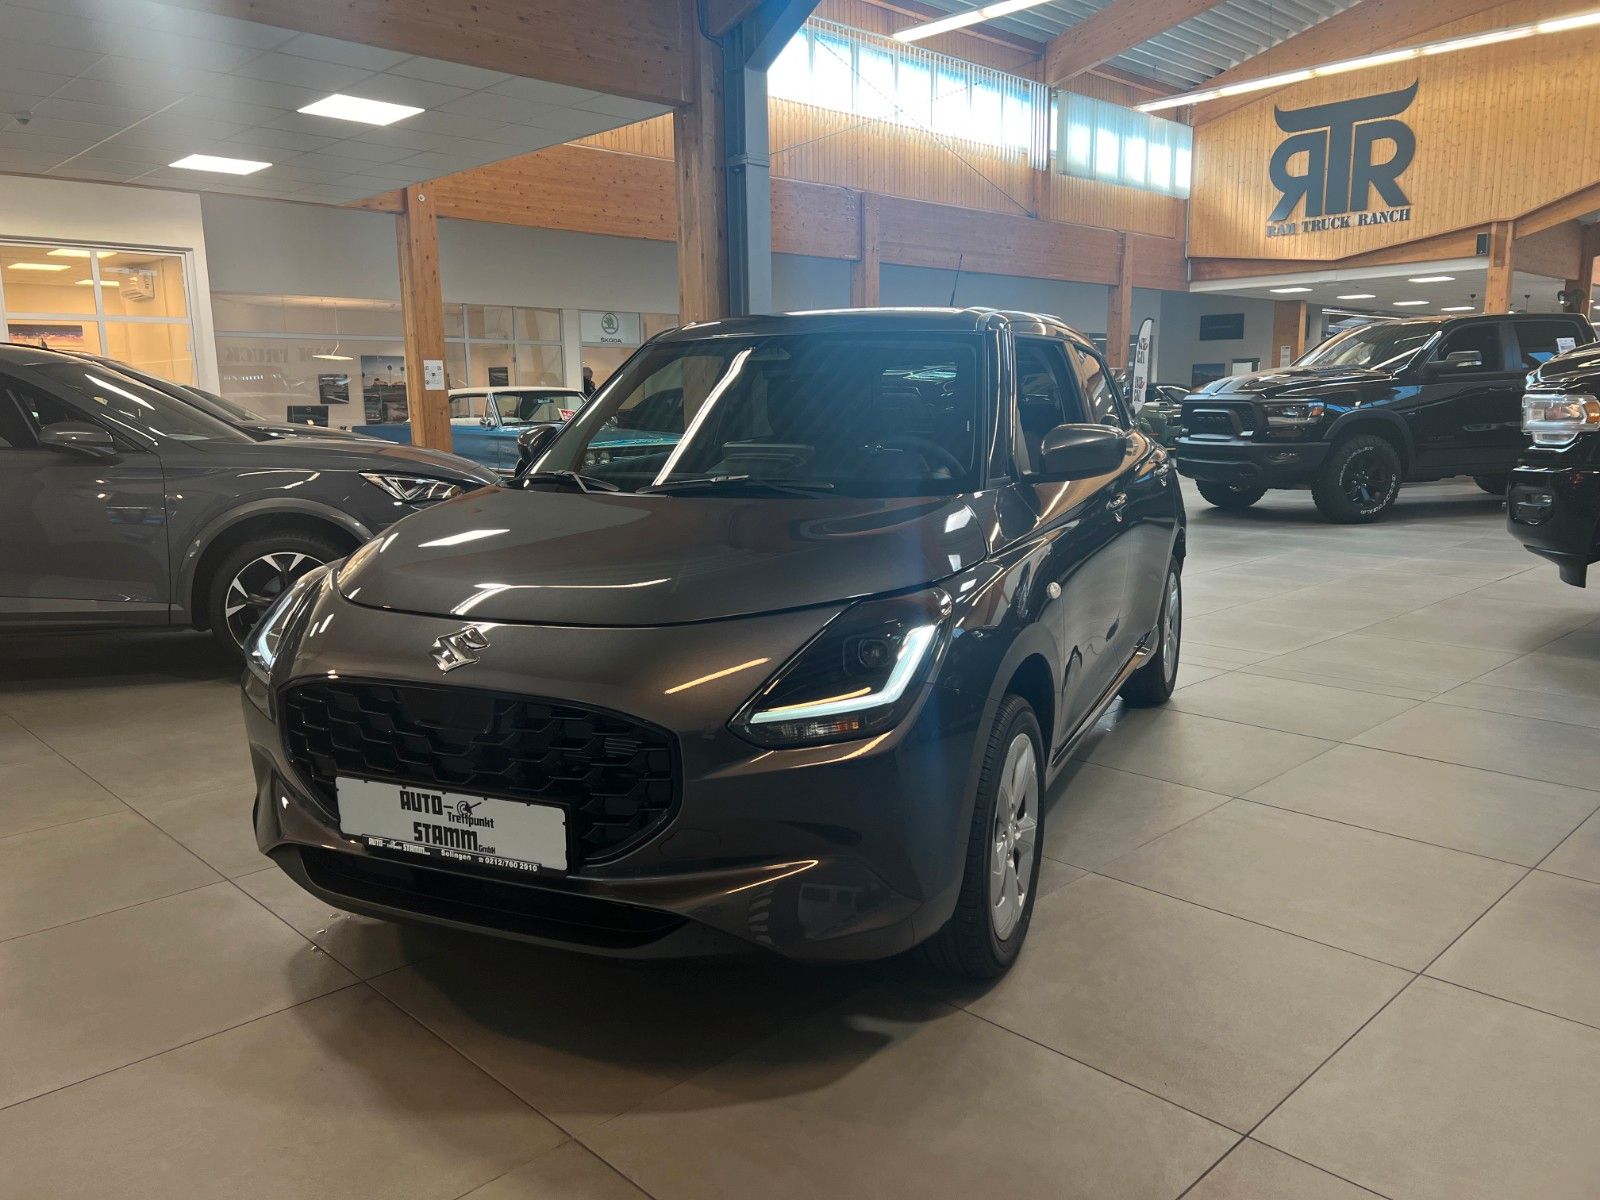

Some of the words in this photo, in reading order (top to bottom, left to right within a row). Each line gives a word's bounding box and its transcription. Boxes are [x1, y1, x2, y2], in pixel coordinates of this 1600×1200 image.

[1266, 222, 1296, 238] RAM
[1302, 214, 1351, 232] TRUCK
[1358, 207, 1411, 227] RANCH
[447, 811, 494, 829] Treffpunkt
[413, 821, 478, 851] STAMM
[441, 849, 472, 861] Solingen
